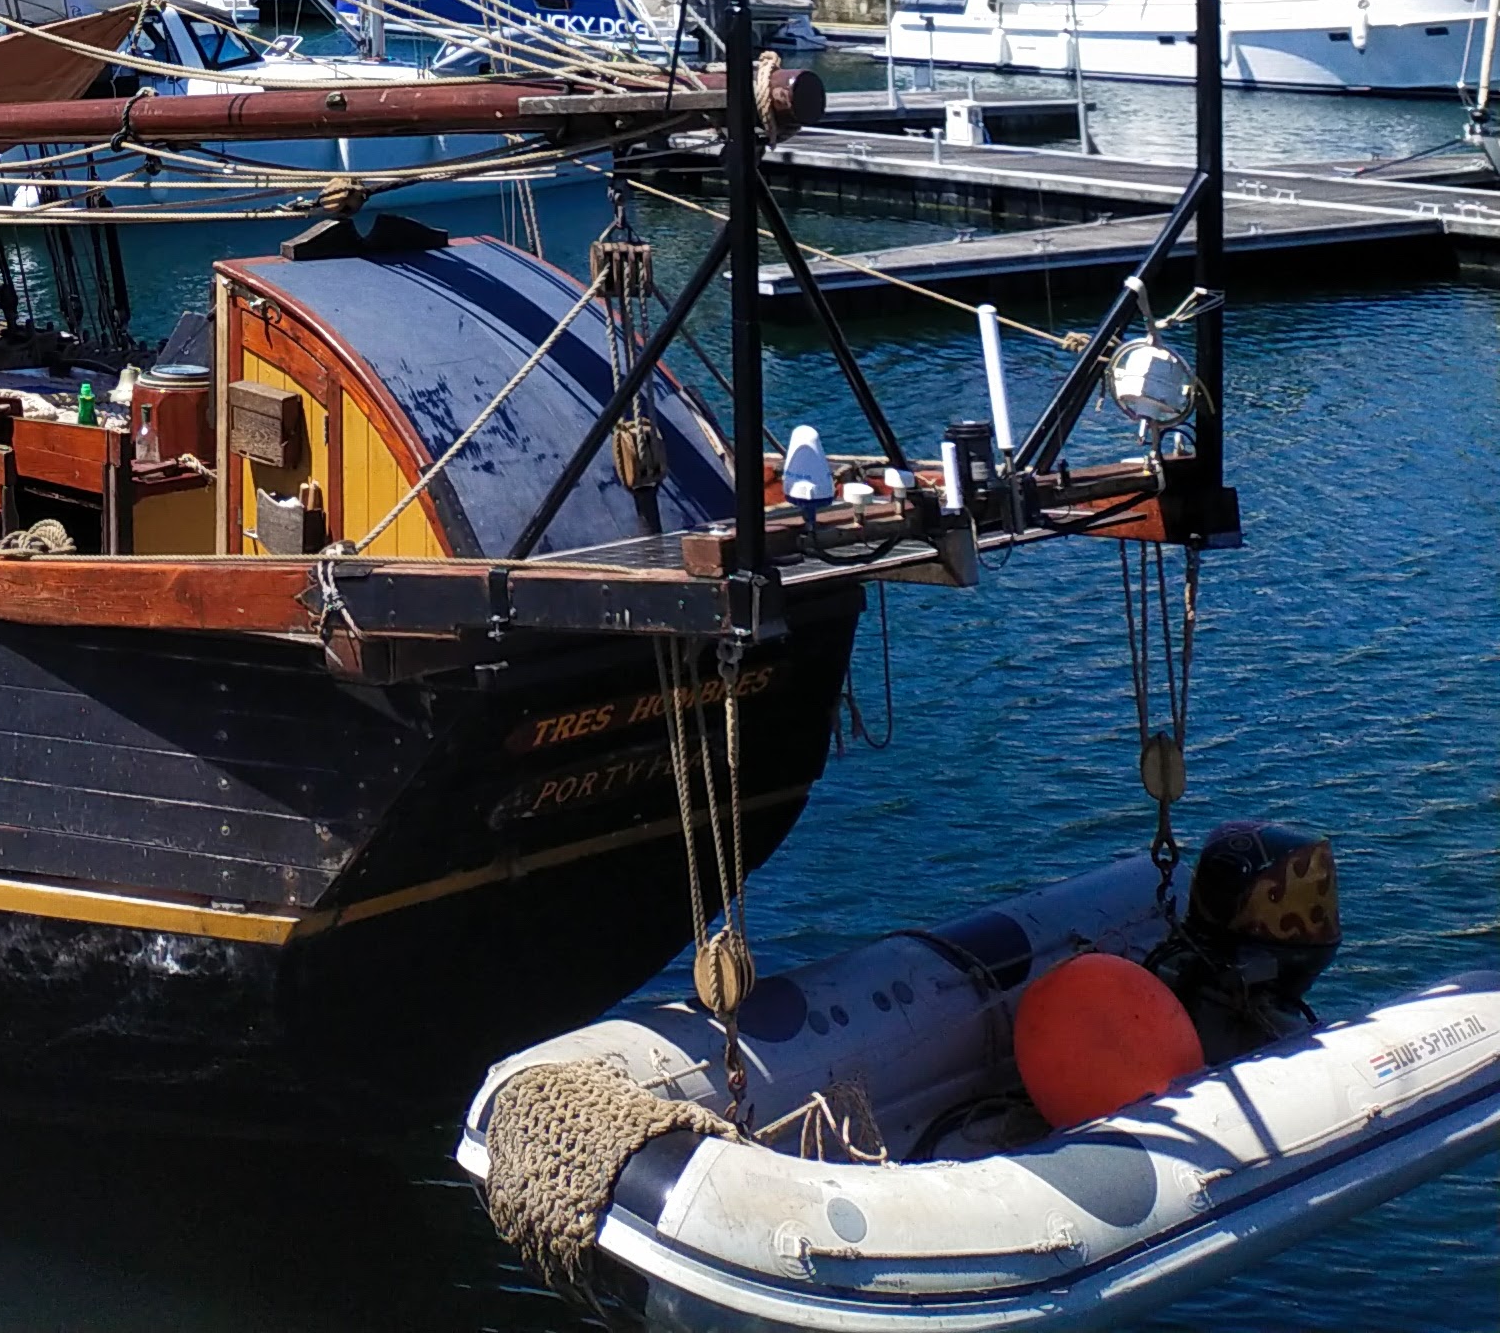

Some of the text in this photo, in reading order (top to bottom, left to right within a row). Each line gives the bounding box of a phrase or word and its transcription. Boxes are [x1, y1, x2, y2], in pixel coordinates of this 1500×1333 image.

[526, 12, 649, 38] LUCKY DOG
[532, 704, 616, 748] TRES
